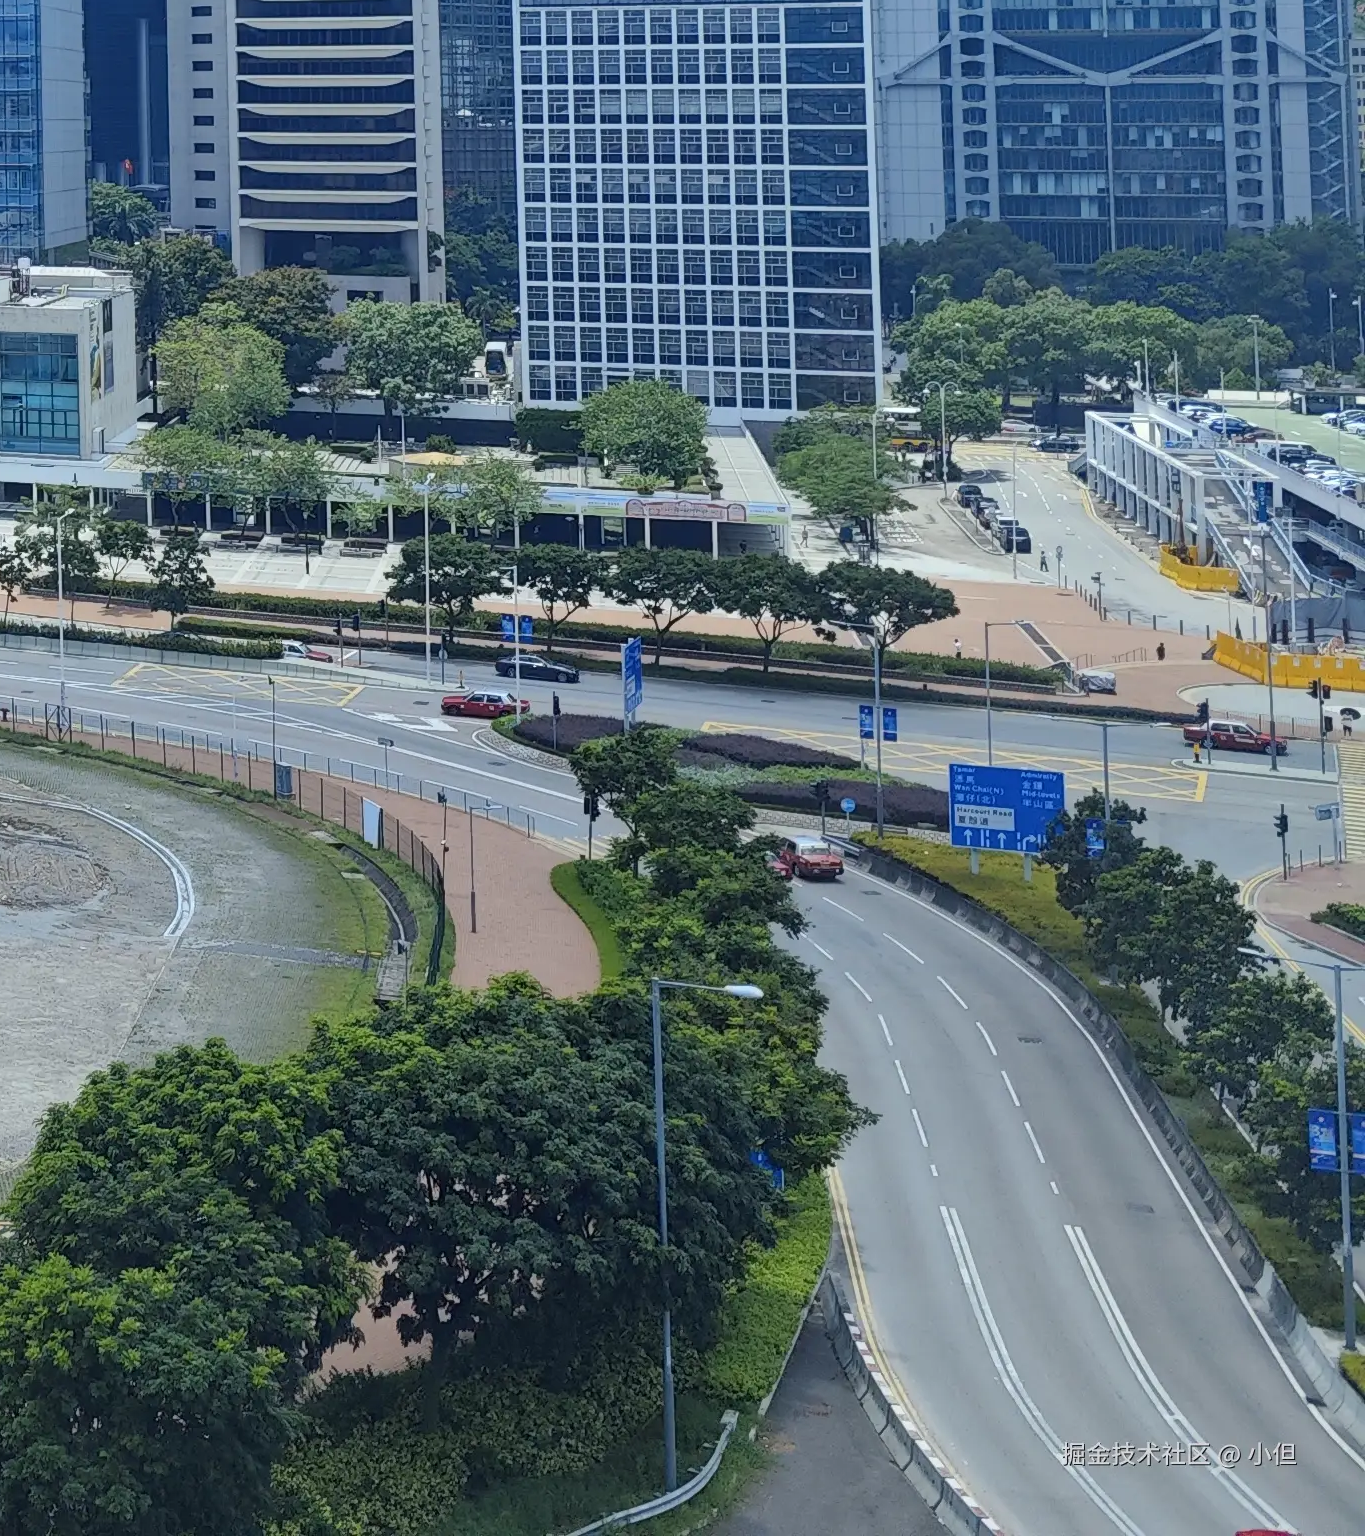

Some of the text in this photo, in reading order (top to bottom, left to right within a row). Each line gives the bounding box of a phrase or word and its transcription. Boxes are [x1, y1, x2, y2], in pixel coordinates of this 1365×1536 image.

[953, 765, 976, 773] Tamar
[1021, 771, 1058, 781] Admiralty
[954, 784, 971, 792] Wan
[956, 806, 1013, 817] Harcourt Road
